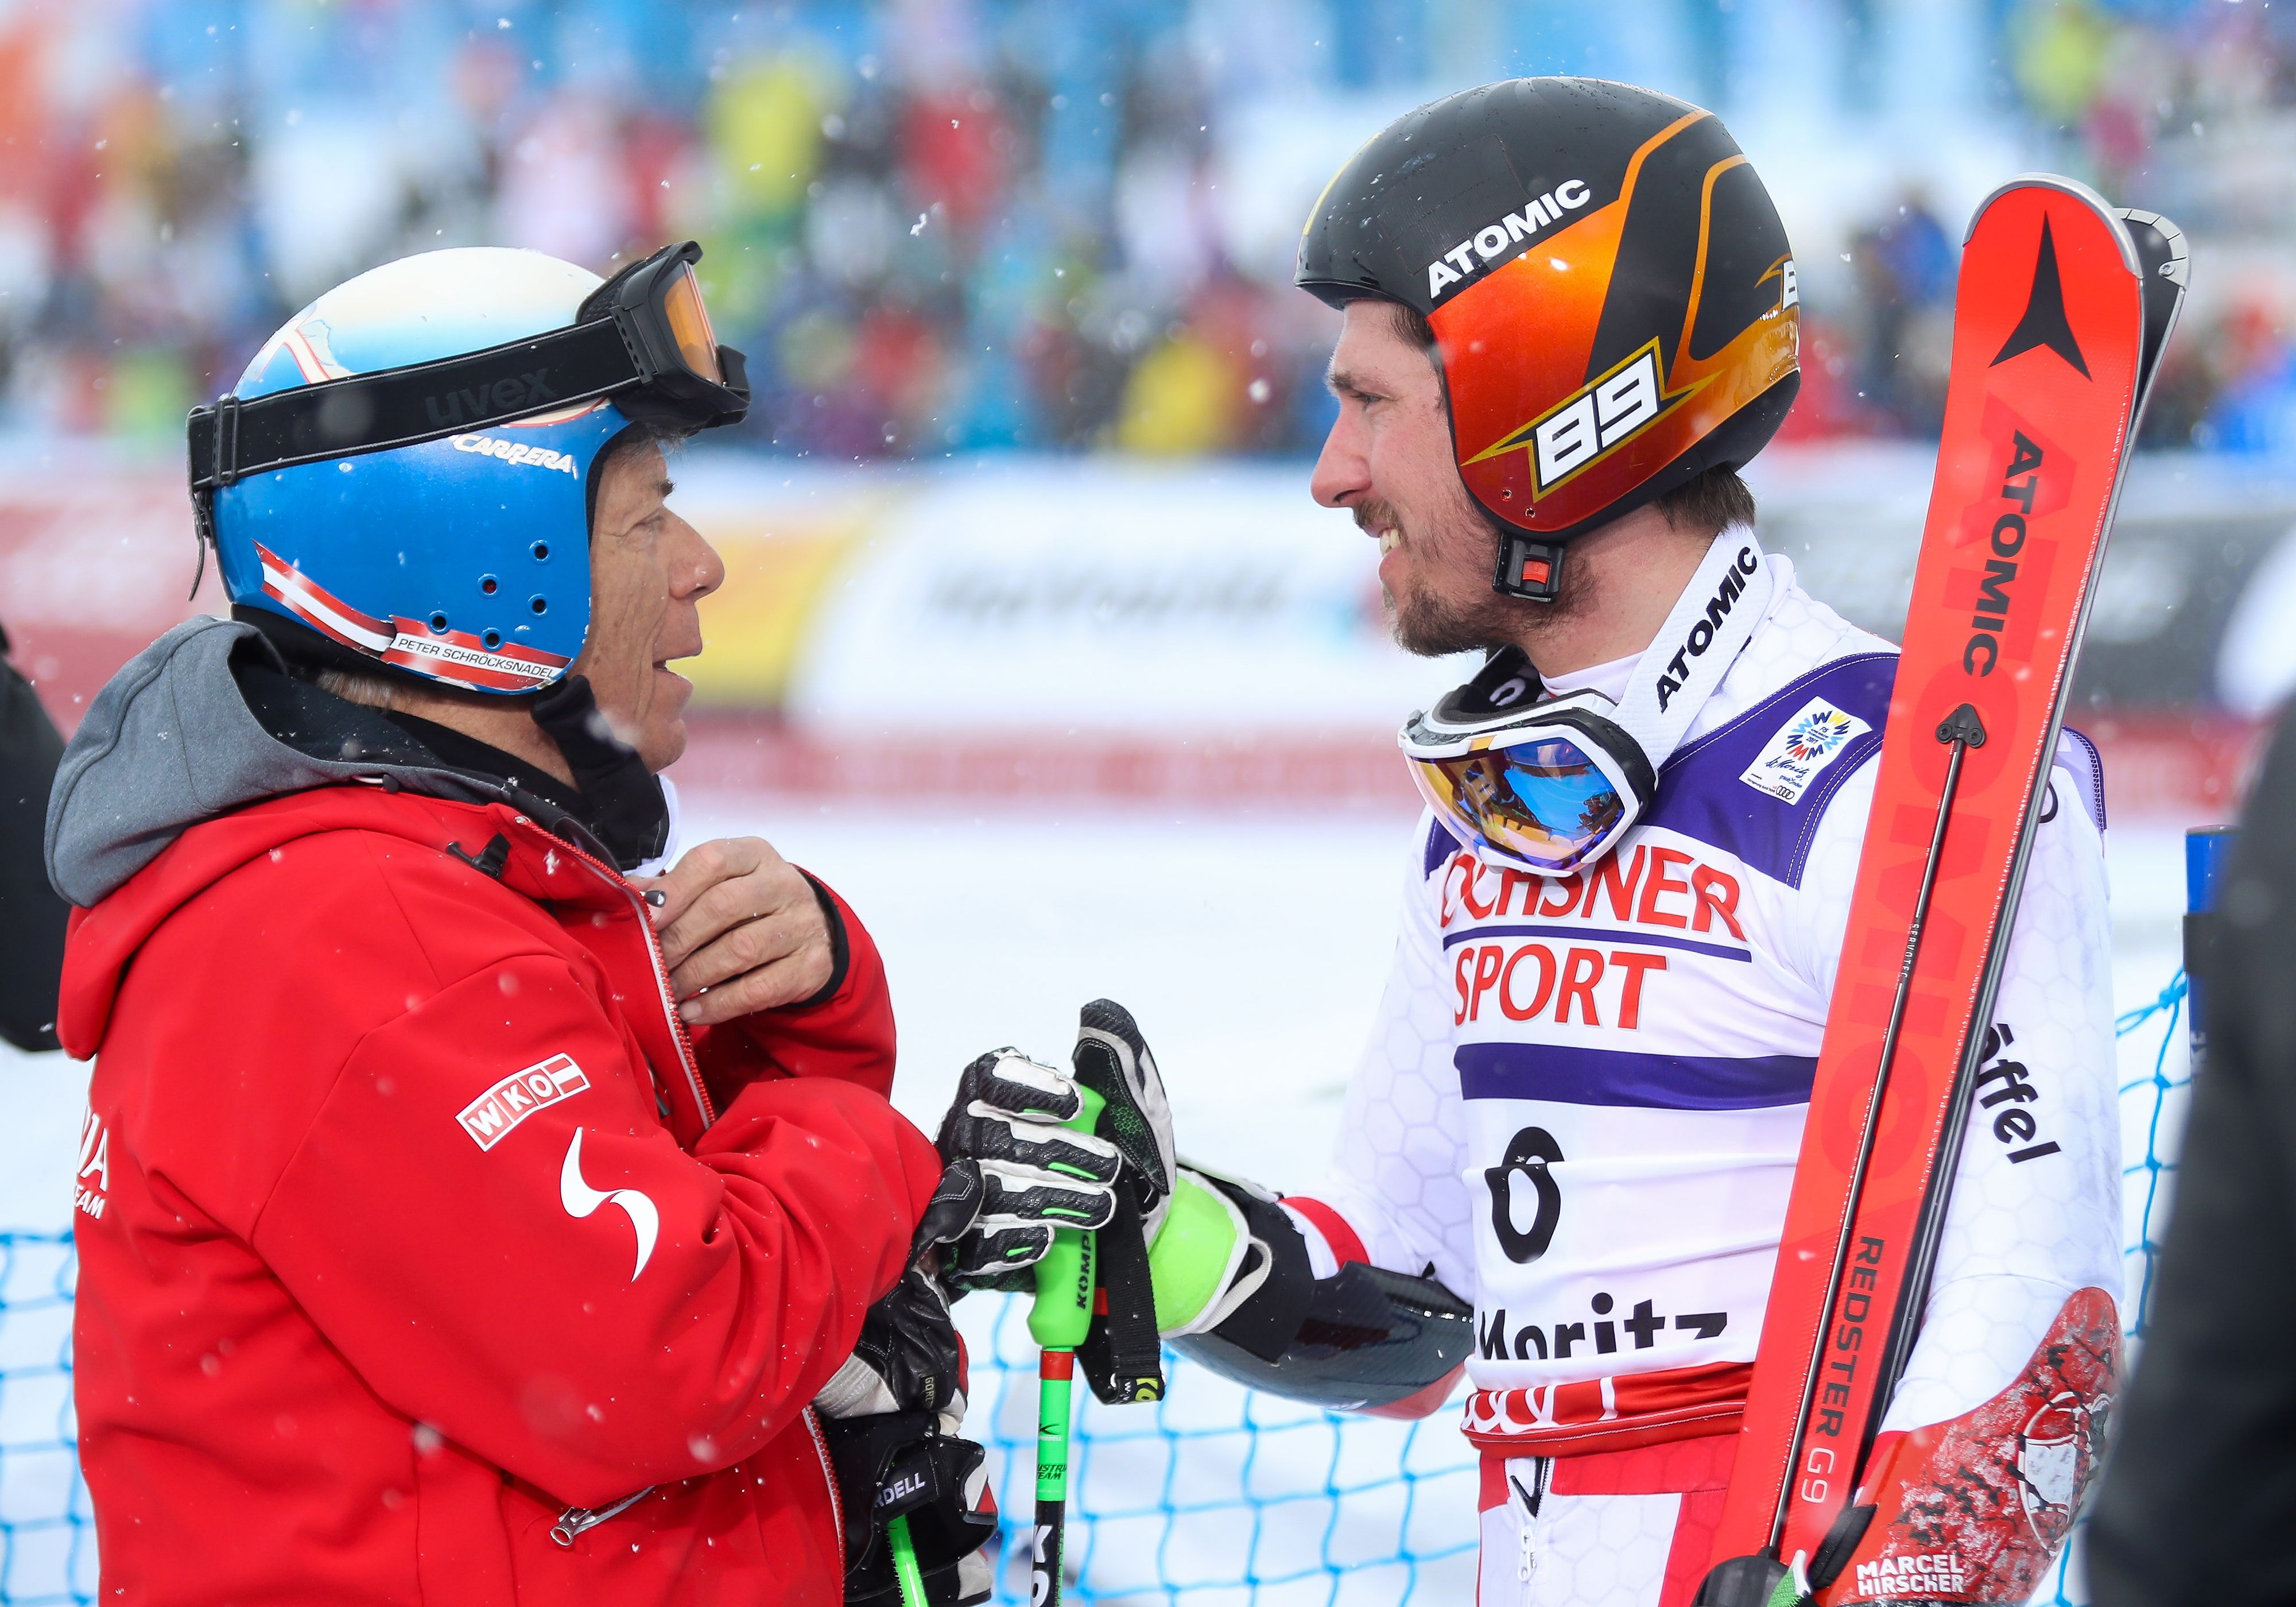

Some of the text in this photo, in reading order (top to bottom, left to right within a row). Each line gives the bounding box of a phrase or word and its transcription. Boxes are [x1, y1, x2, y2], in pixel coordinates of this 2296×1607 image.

[1428, 179, 1591, 299] ATOMIC
[425, 367, 557, 427] uvex
[452, 433, 573, 473] CARRERA
[1963, 428, 2044, 678] ATOMIC
[398, 638, 554, 679] PETER SCHRÖCKSNADEL
[1655, 545, 1758, 714] ATOMIC
[1441, 845, 1748, 942] OCHSNER
[1455, 944, 1667, 1029] SPORT
[1901, 923, 1920, 978] SERVOTEC
[467, 1074, 554, 1137] WKO
[1976, 1023, 2062, 1164] öffel
[74, 1183, 106, 1220] EAM
[1484, 1126, 1565, 1264] 6
[1076, 1234, 1092, 1310] KOMP
[1801, 1236, 1884, 1505] REDSTER G9
[1033, 1525, 1053, 1607] KO
[1856, 1554, 1964, 1581] MARCEL
[1857, 1574, 1964, 1597] HIRSCHER
